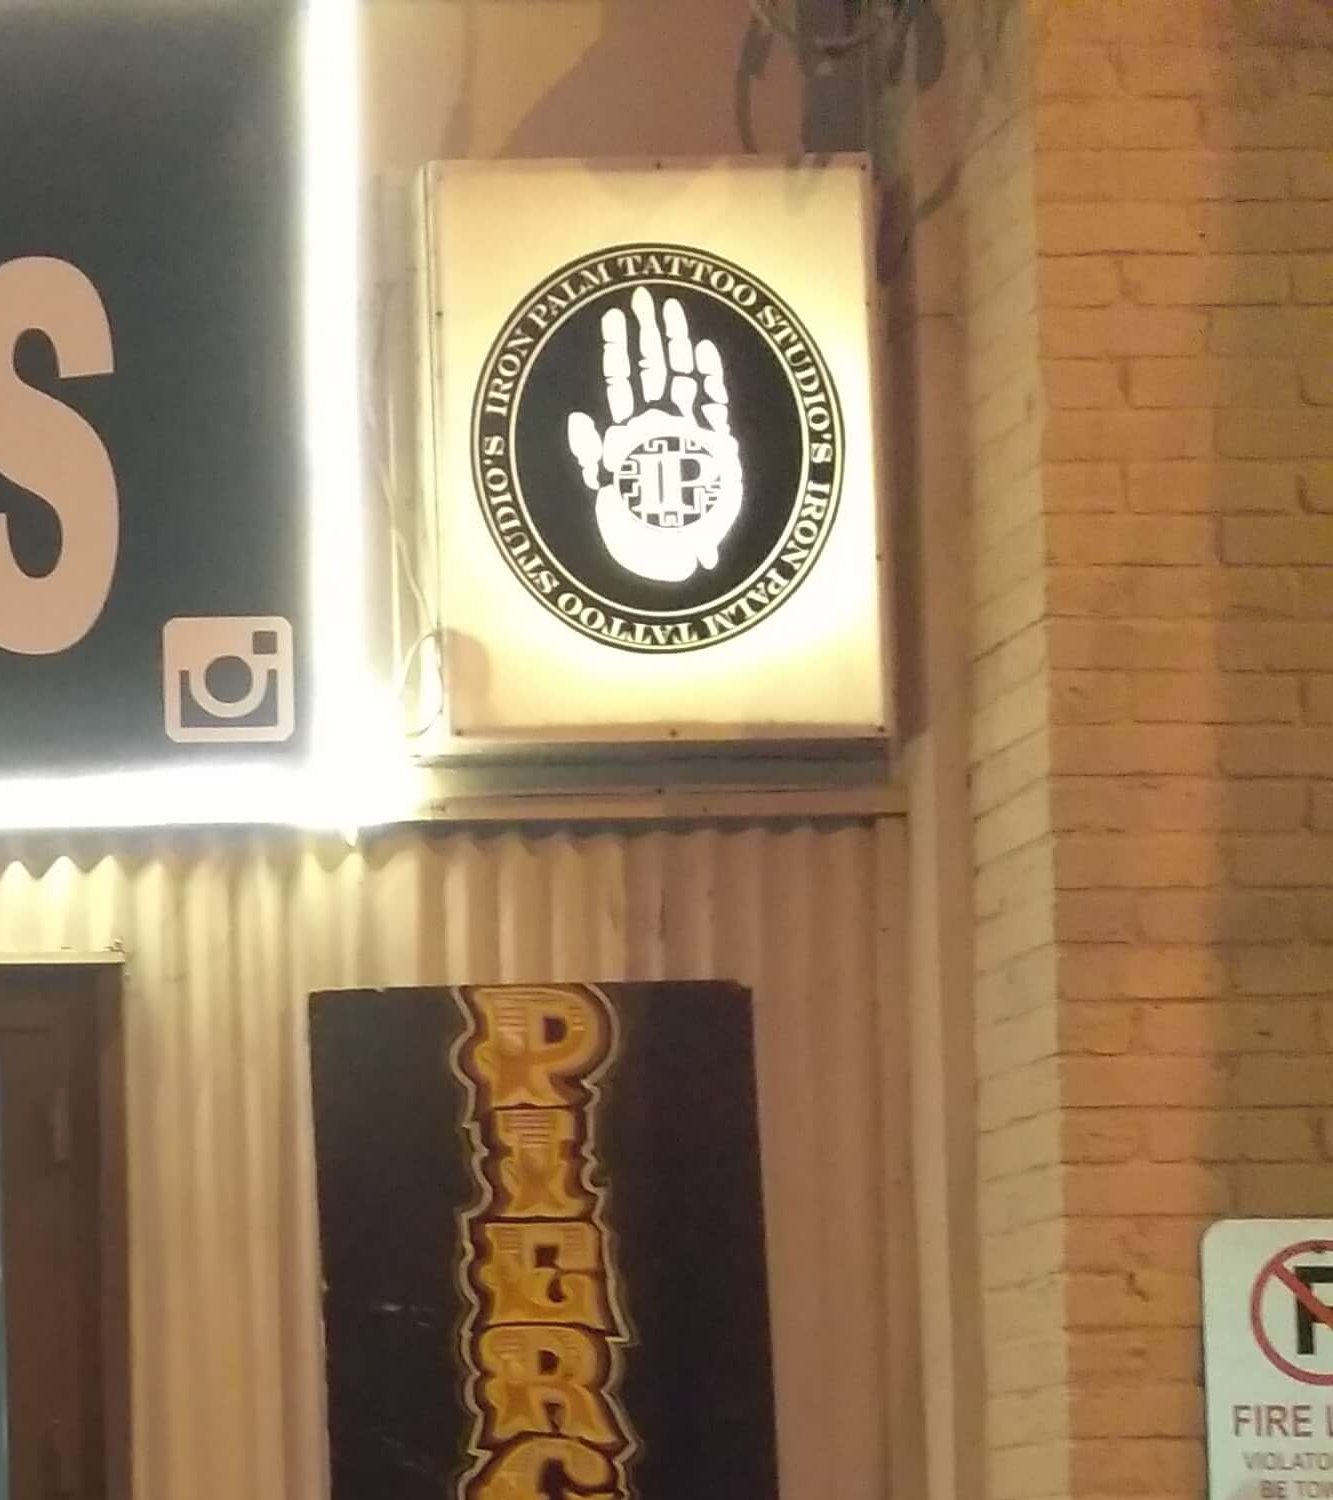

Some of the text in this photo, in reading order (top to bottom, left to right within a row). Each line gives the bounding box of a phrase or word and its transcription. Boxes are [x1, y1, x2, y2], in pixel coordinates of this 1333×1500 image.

[527, 263, 612, 328] PALM
[617, 255, 757, 306] TATTOO
[486, 327, 534, 416] IRON
[781, 480, 832, 571] IRON
[557, 592, 699, 645] TATTOO
[701, 568, 790, 637] PALM
[1233, 1404, 1313, 1437] FIRE
